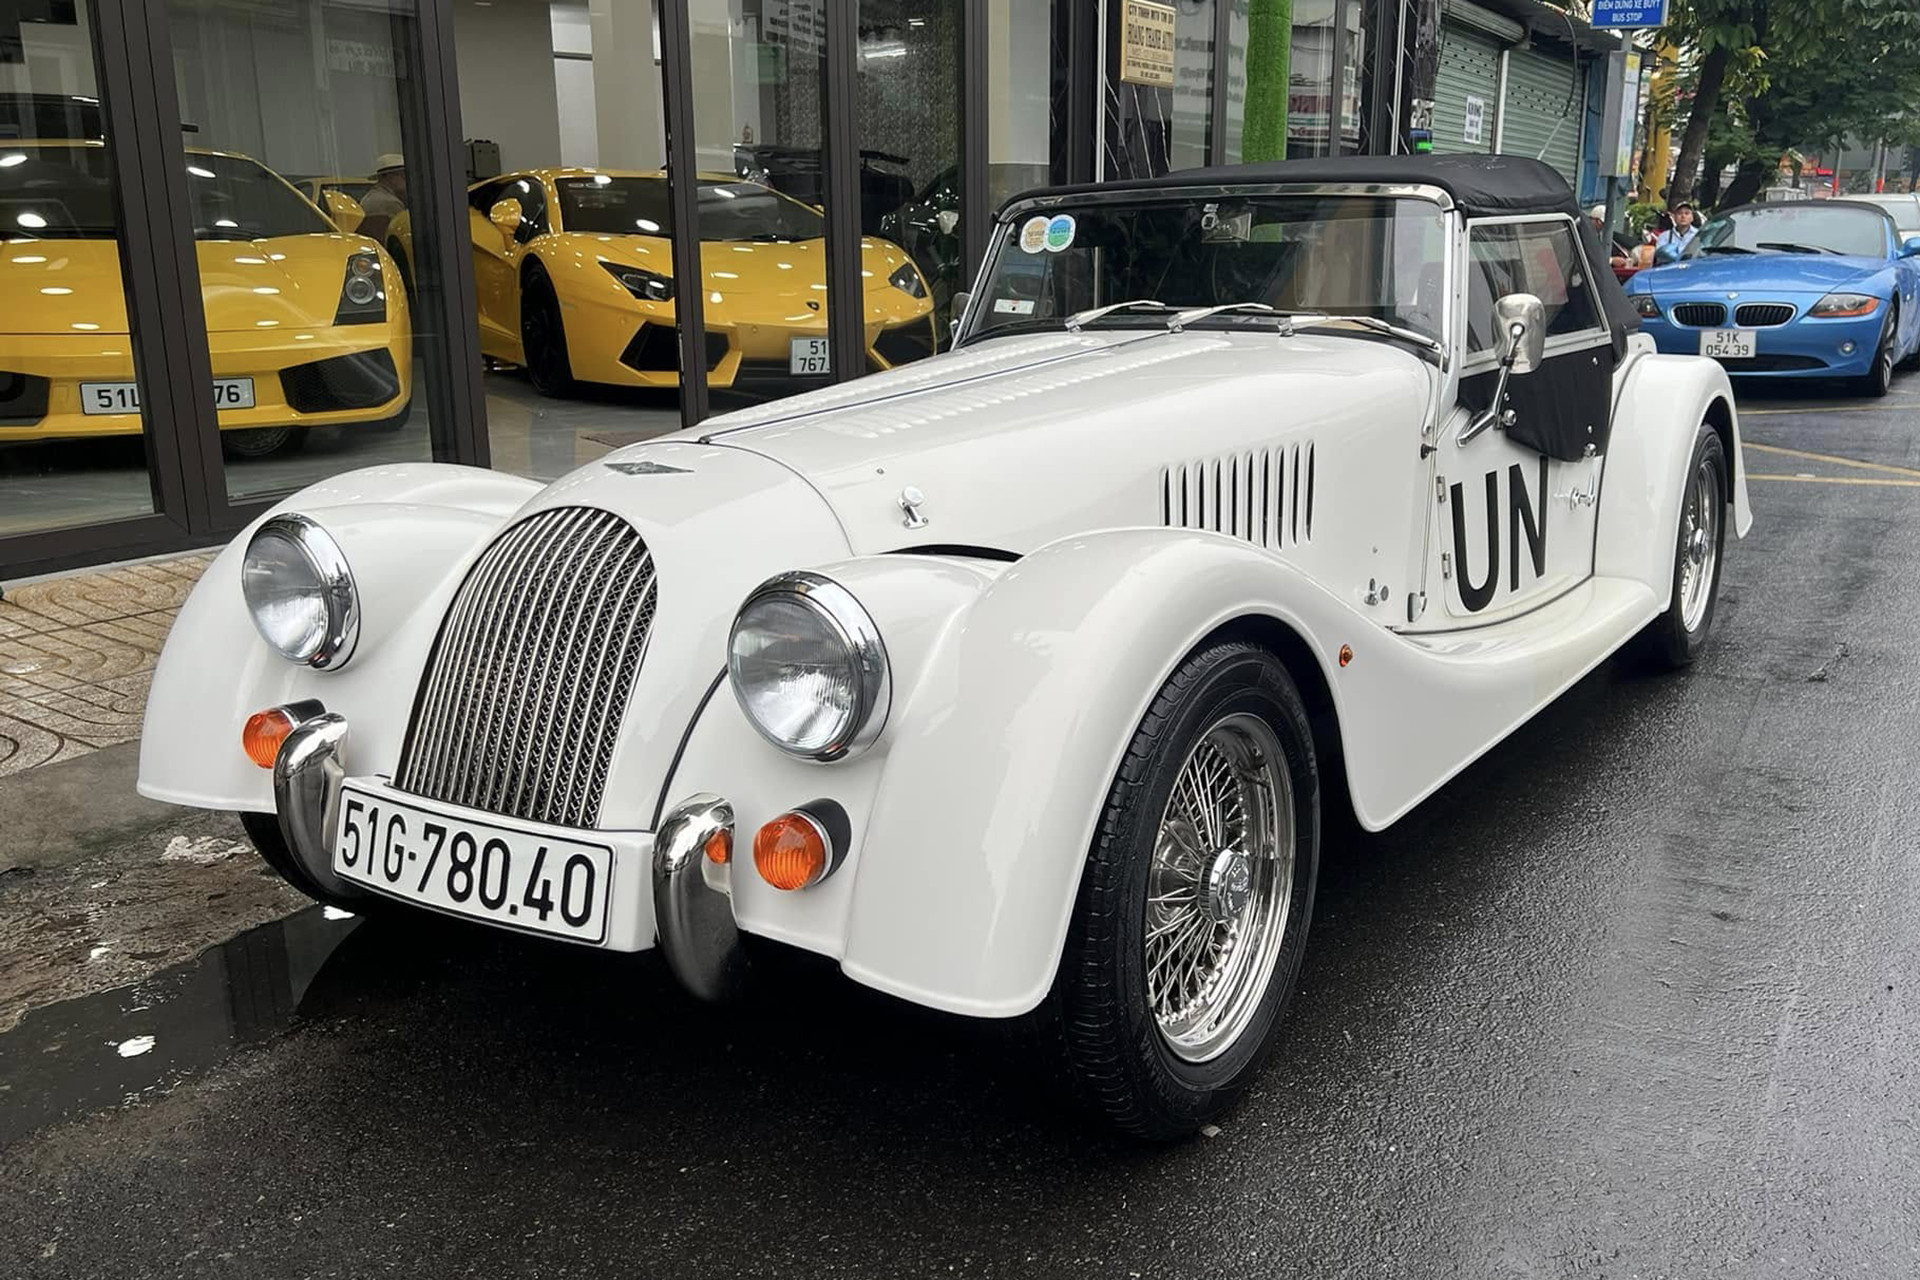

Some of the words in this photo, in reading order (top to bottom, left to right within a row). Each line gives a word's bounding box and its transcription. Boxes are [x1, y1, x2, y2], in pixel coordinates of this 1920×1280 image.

[1612, 13, 1626, 22] BUS
[1626, 12, 1643, 22] STOP
[1716, 331, 1739, 344] 51K
[1705, 344, 1749, 356] 054.39
[1450, 455, 1549, 613] UN
[341, 799, 596, 928] 51G-780.40
